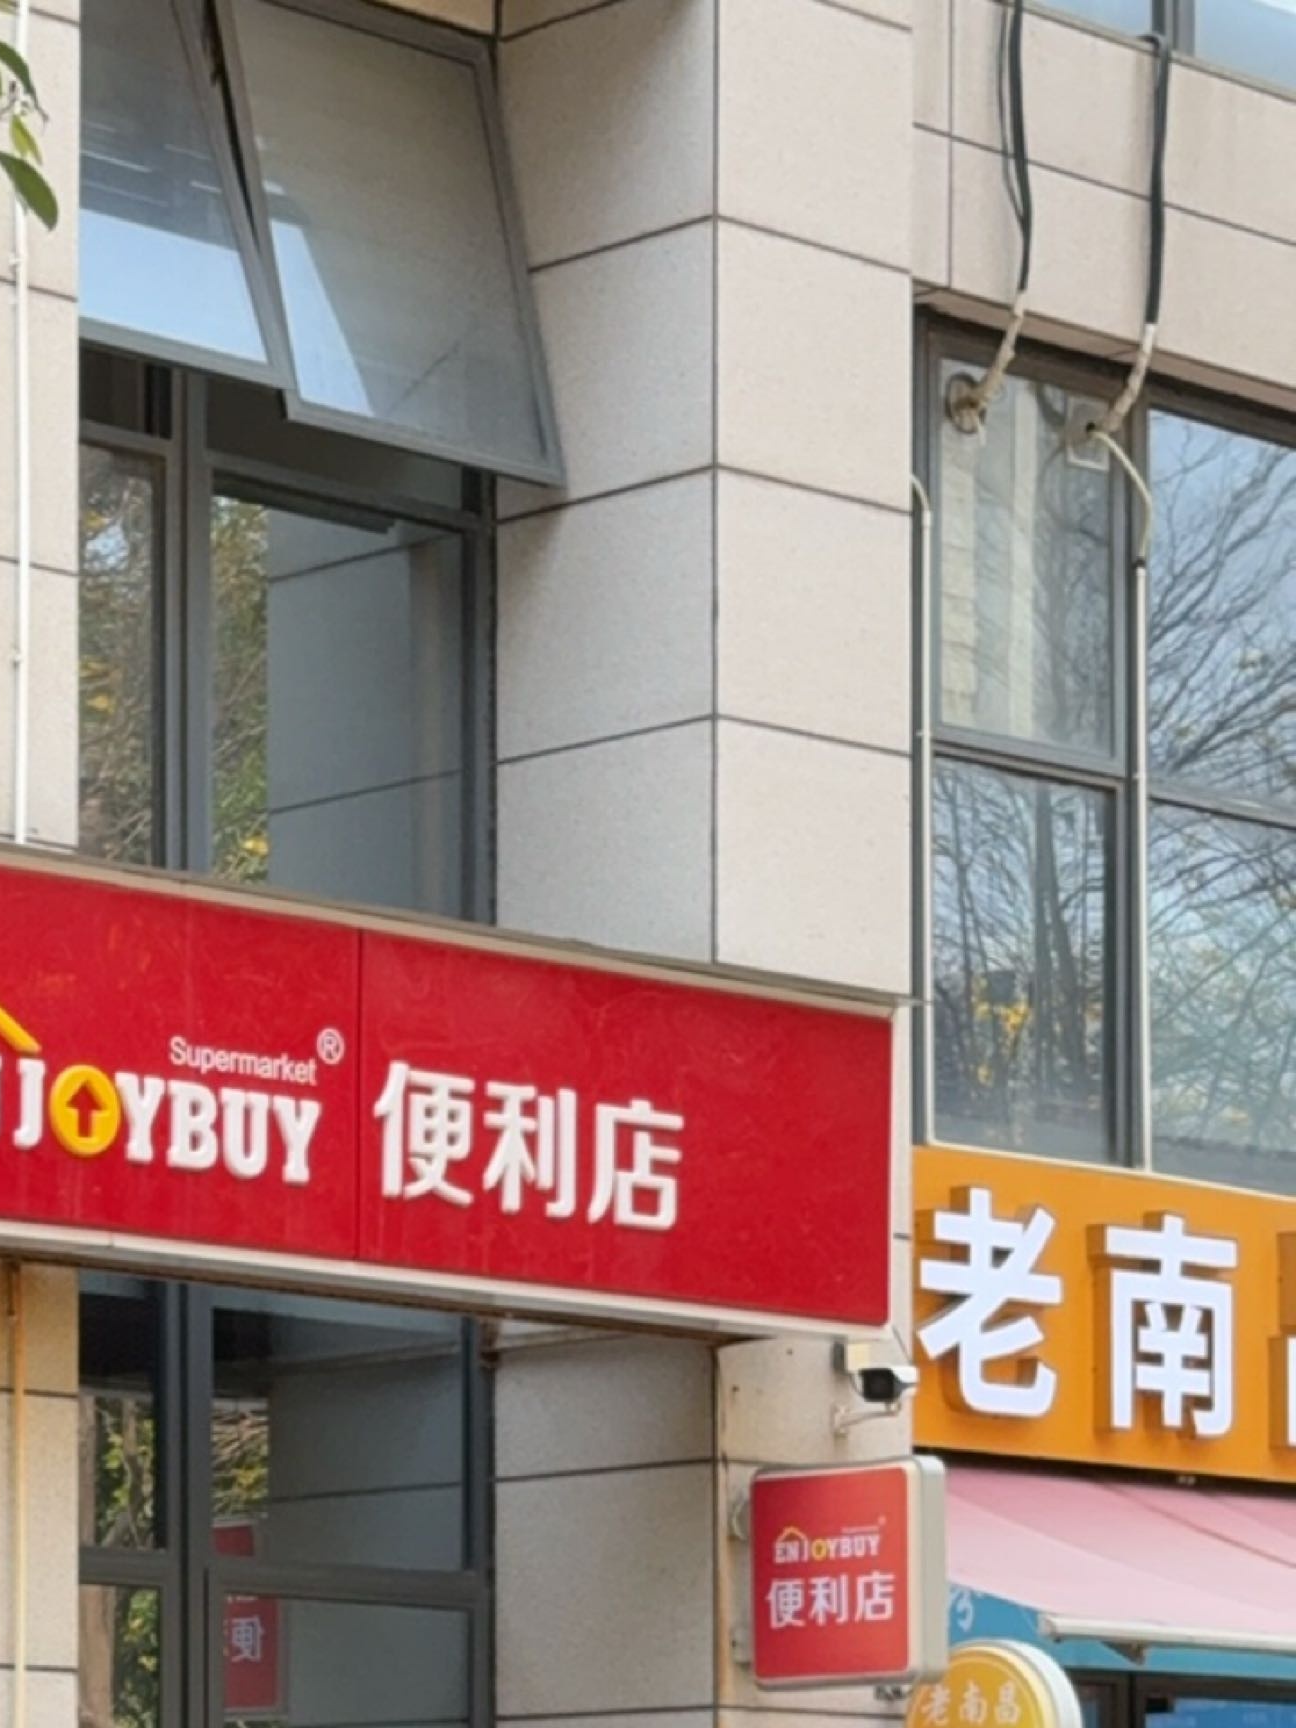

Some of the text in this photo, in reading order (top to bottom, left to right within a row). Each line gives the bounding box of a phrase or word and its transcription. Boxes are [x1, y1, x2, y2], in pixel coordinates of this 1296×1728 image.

[169, 1035, 318, 1086] Supermarket
[373, 1059, 686, 1232] 便利店
[917, 1186, 1296, 1448] 老南
[773, 1534, 881, 1564] ENJOYBUY
[765, 1570, 897, 1629] 便利店
[921, 1678, 1022, 1727] 老南昌
